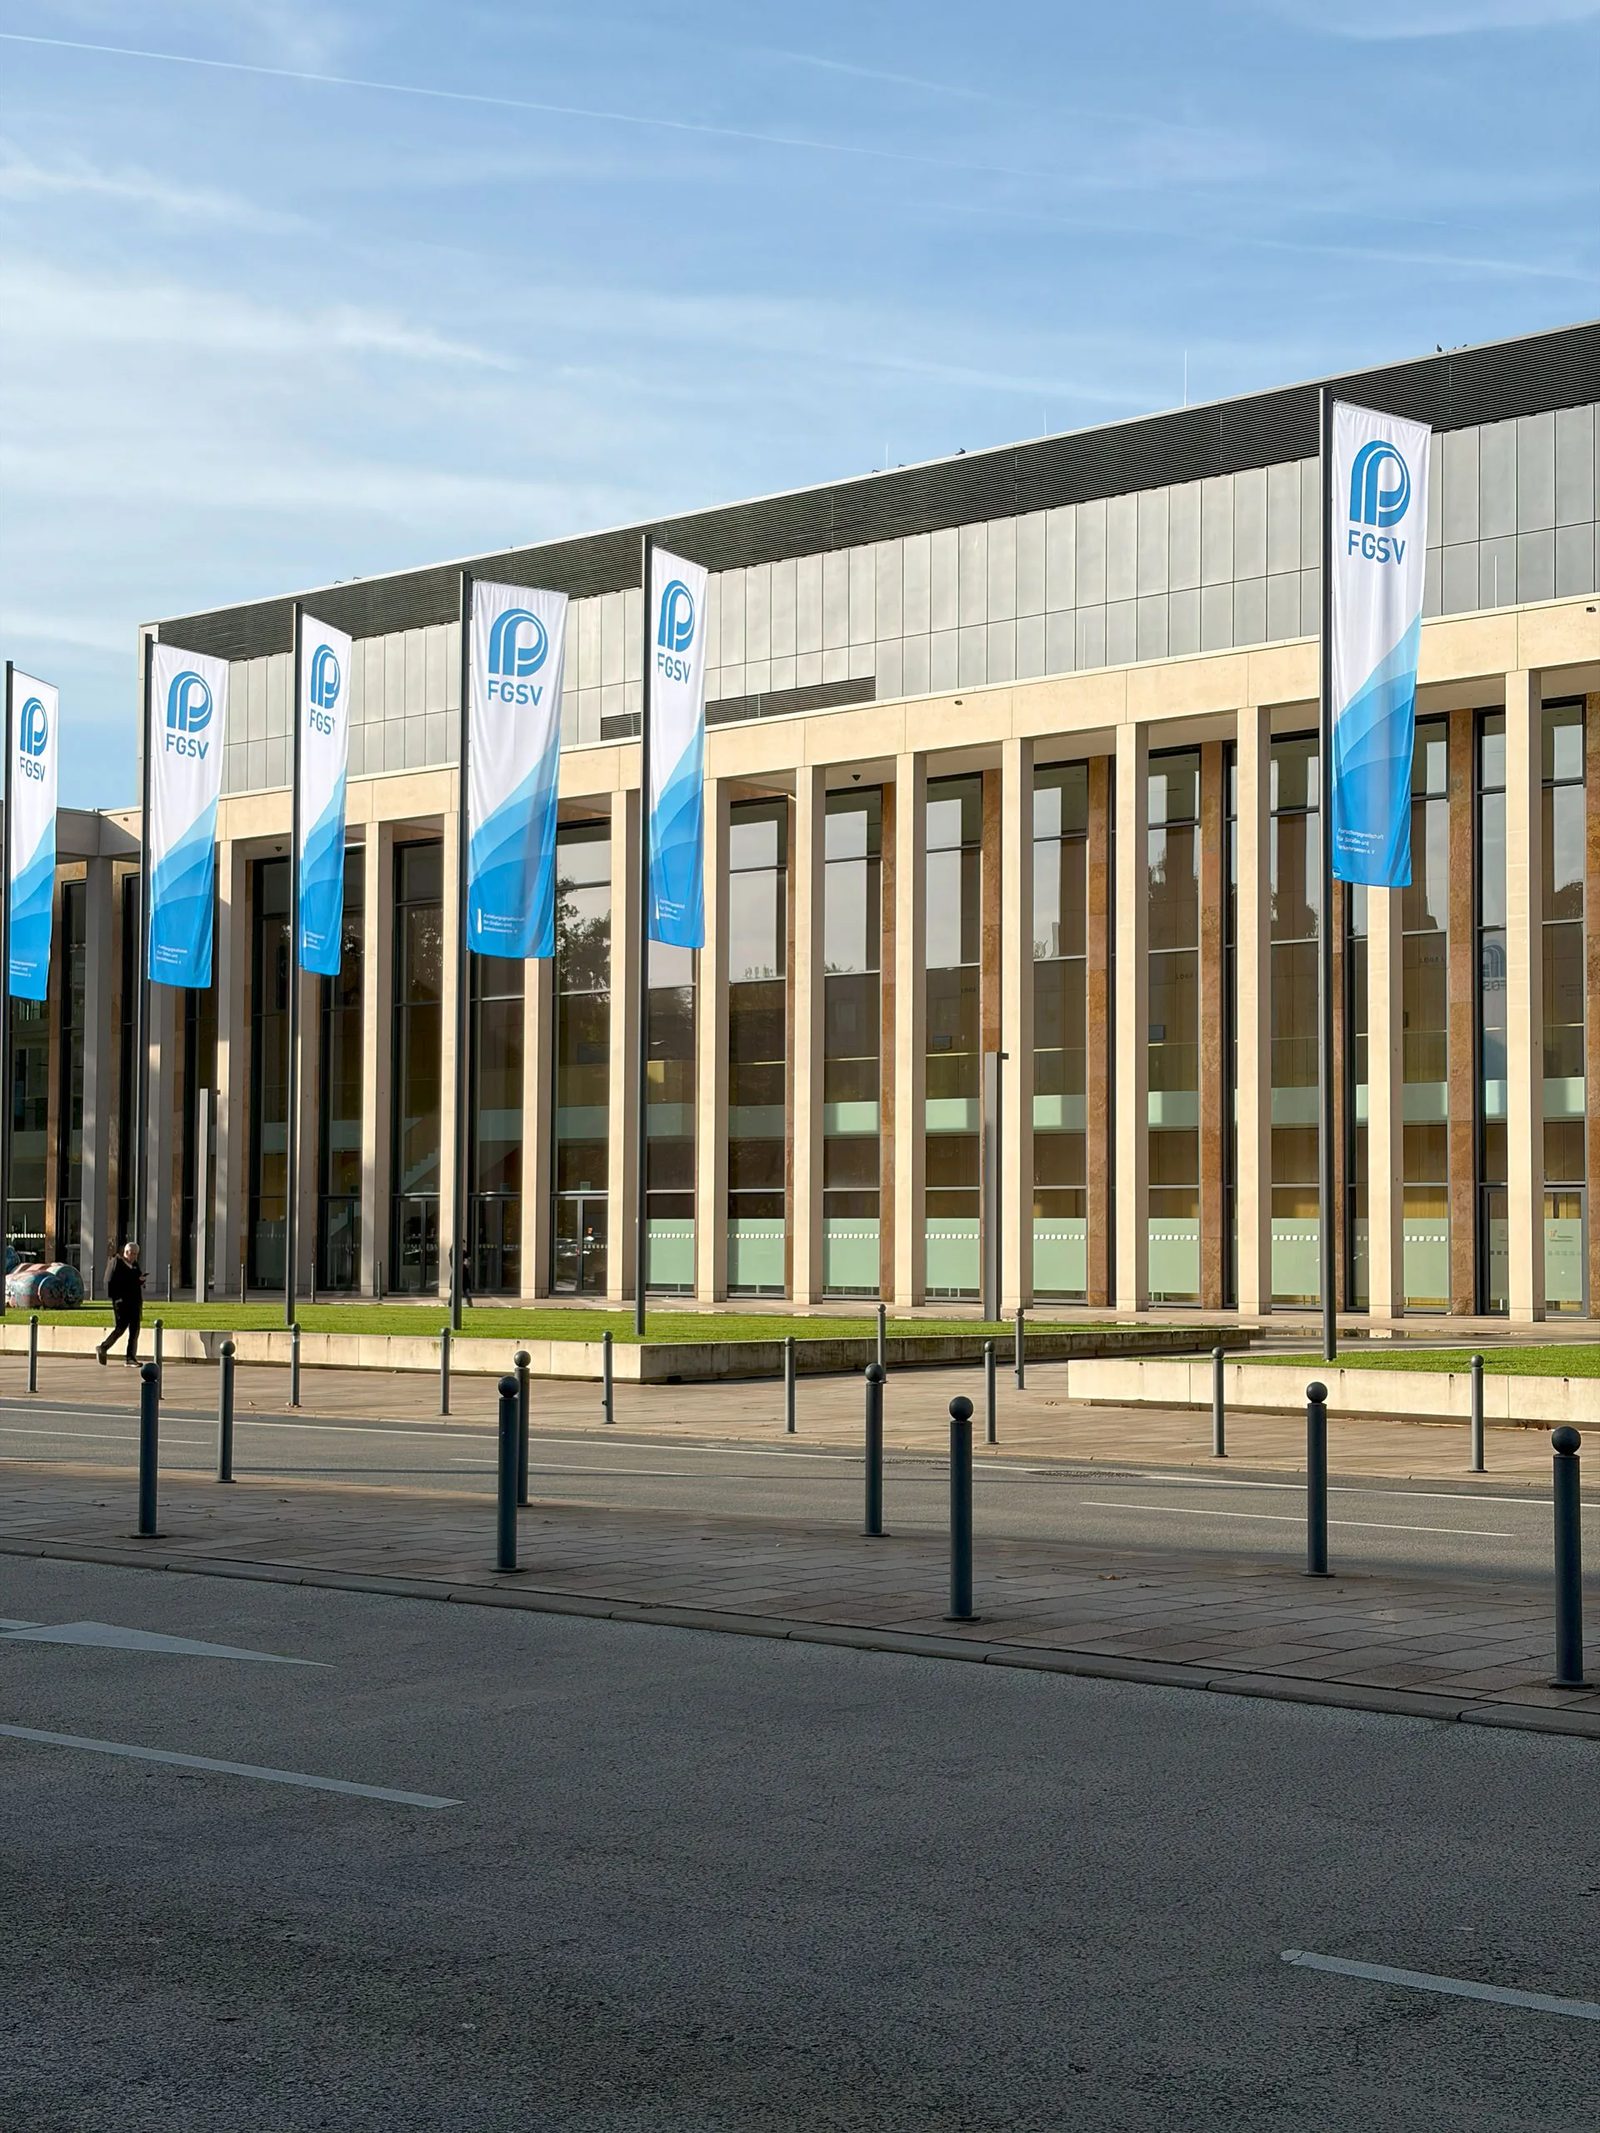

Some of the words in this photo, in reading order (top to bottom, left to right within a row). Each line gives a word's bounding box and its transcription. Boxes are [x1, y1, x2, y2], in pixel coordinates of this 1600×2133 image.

[1348, 529, 1405, 565] FGSV
[657, 652, 691, 684] FGSV
[488, 679, 543, 707] FGSV
[166, 733, 209, 760] FGSV
[19, 757, 45, 783] FGSV
